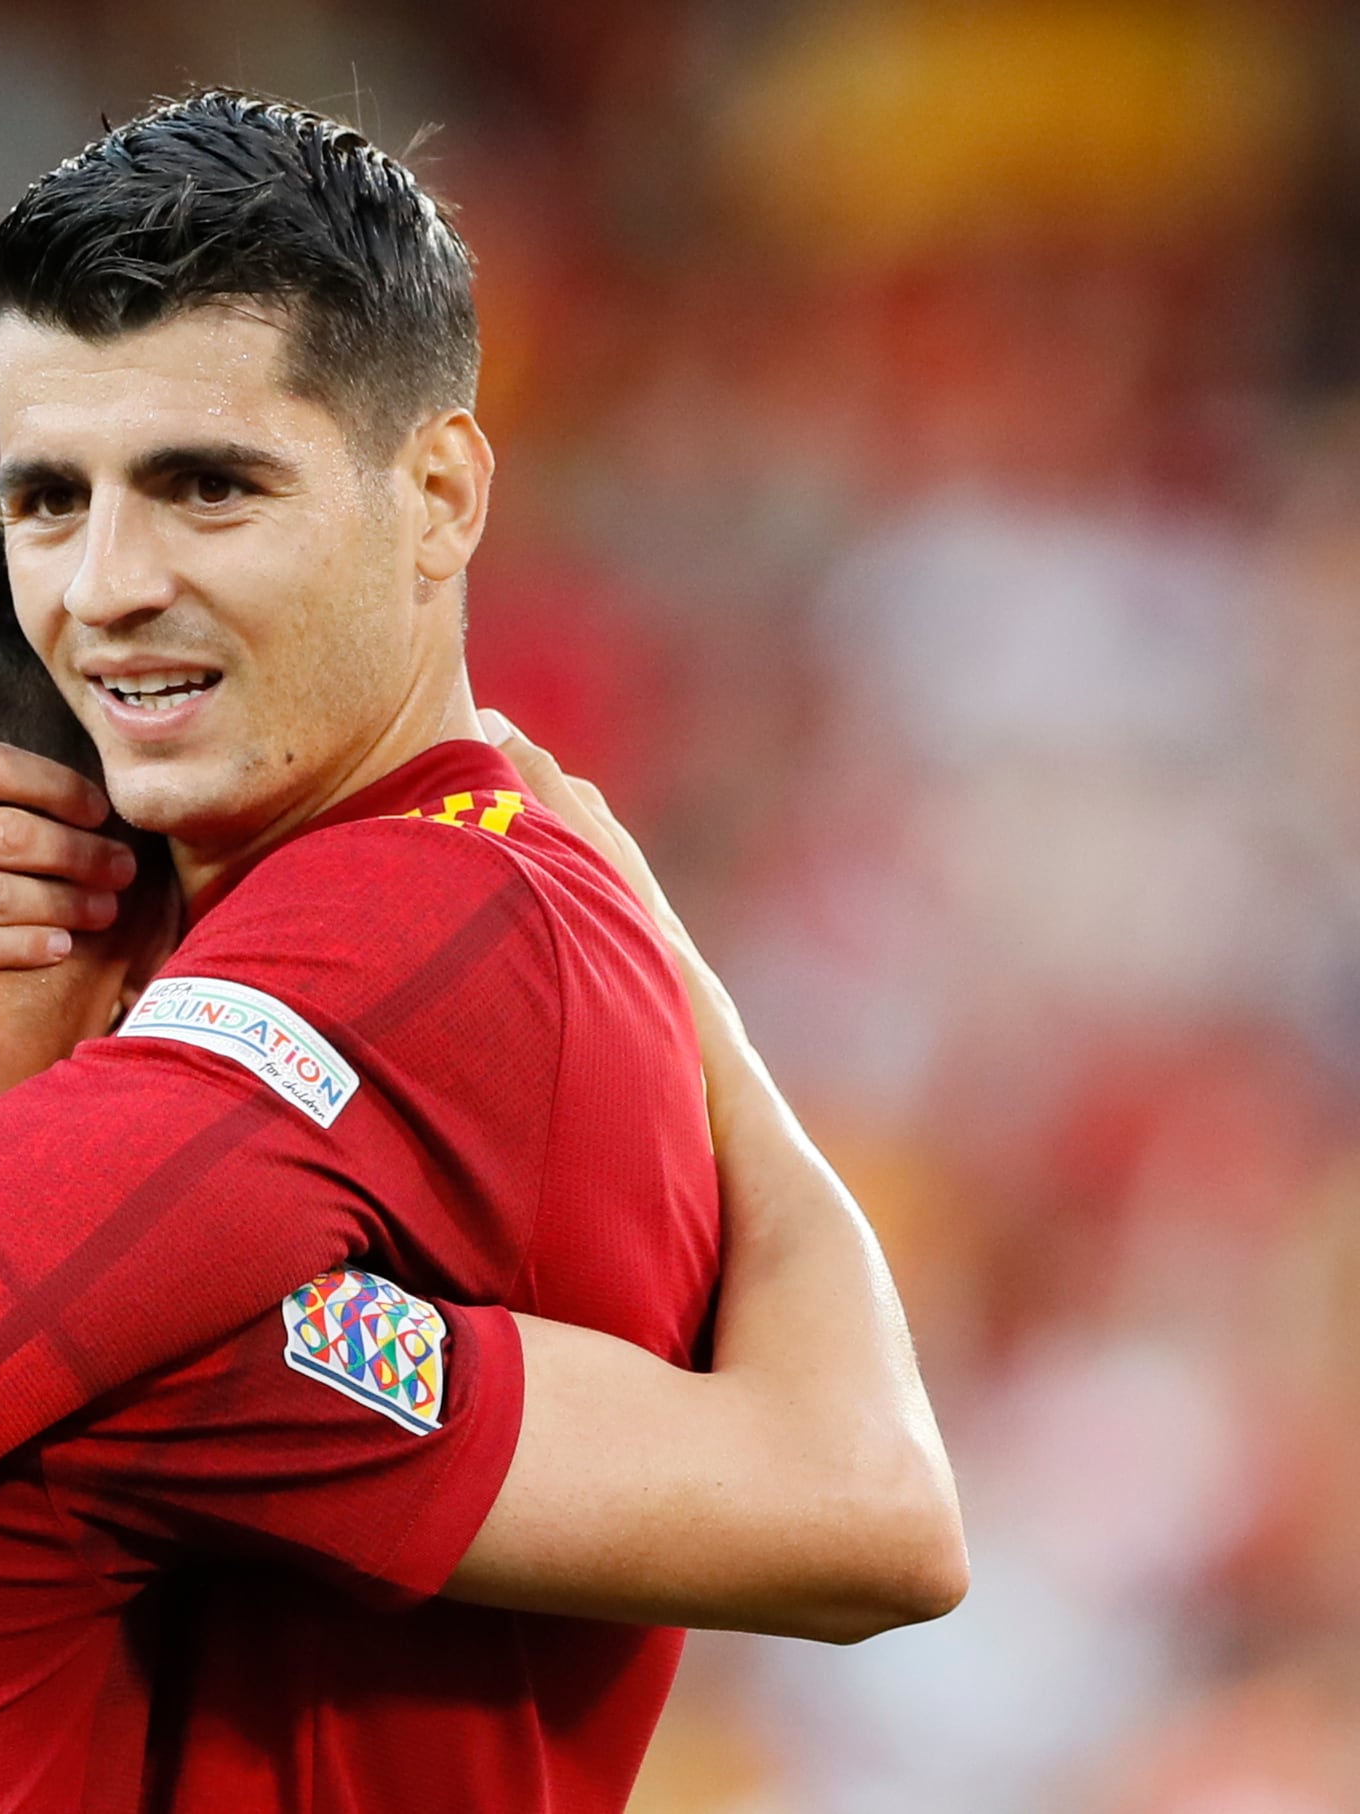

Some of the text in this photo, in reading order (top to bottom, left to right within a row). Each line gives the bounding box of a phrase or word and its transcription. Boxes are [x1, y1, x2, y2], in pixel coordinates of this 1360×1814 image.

[134, 999, 343, 1107] FOUNDATION
[258, 1061, 326, 1121] for children
